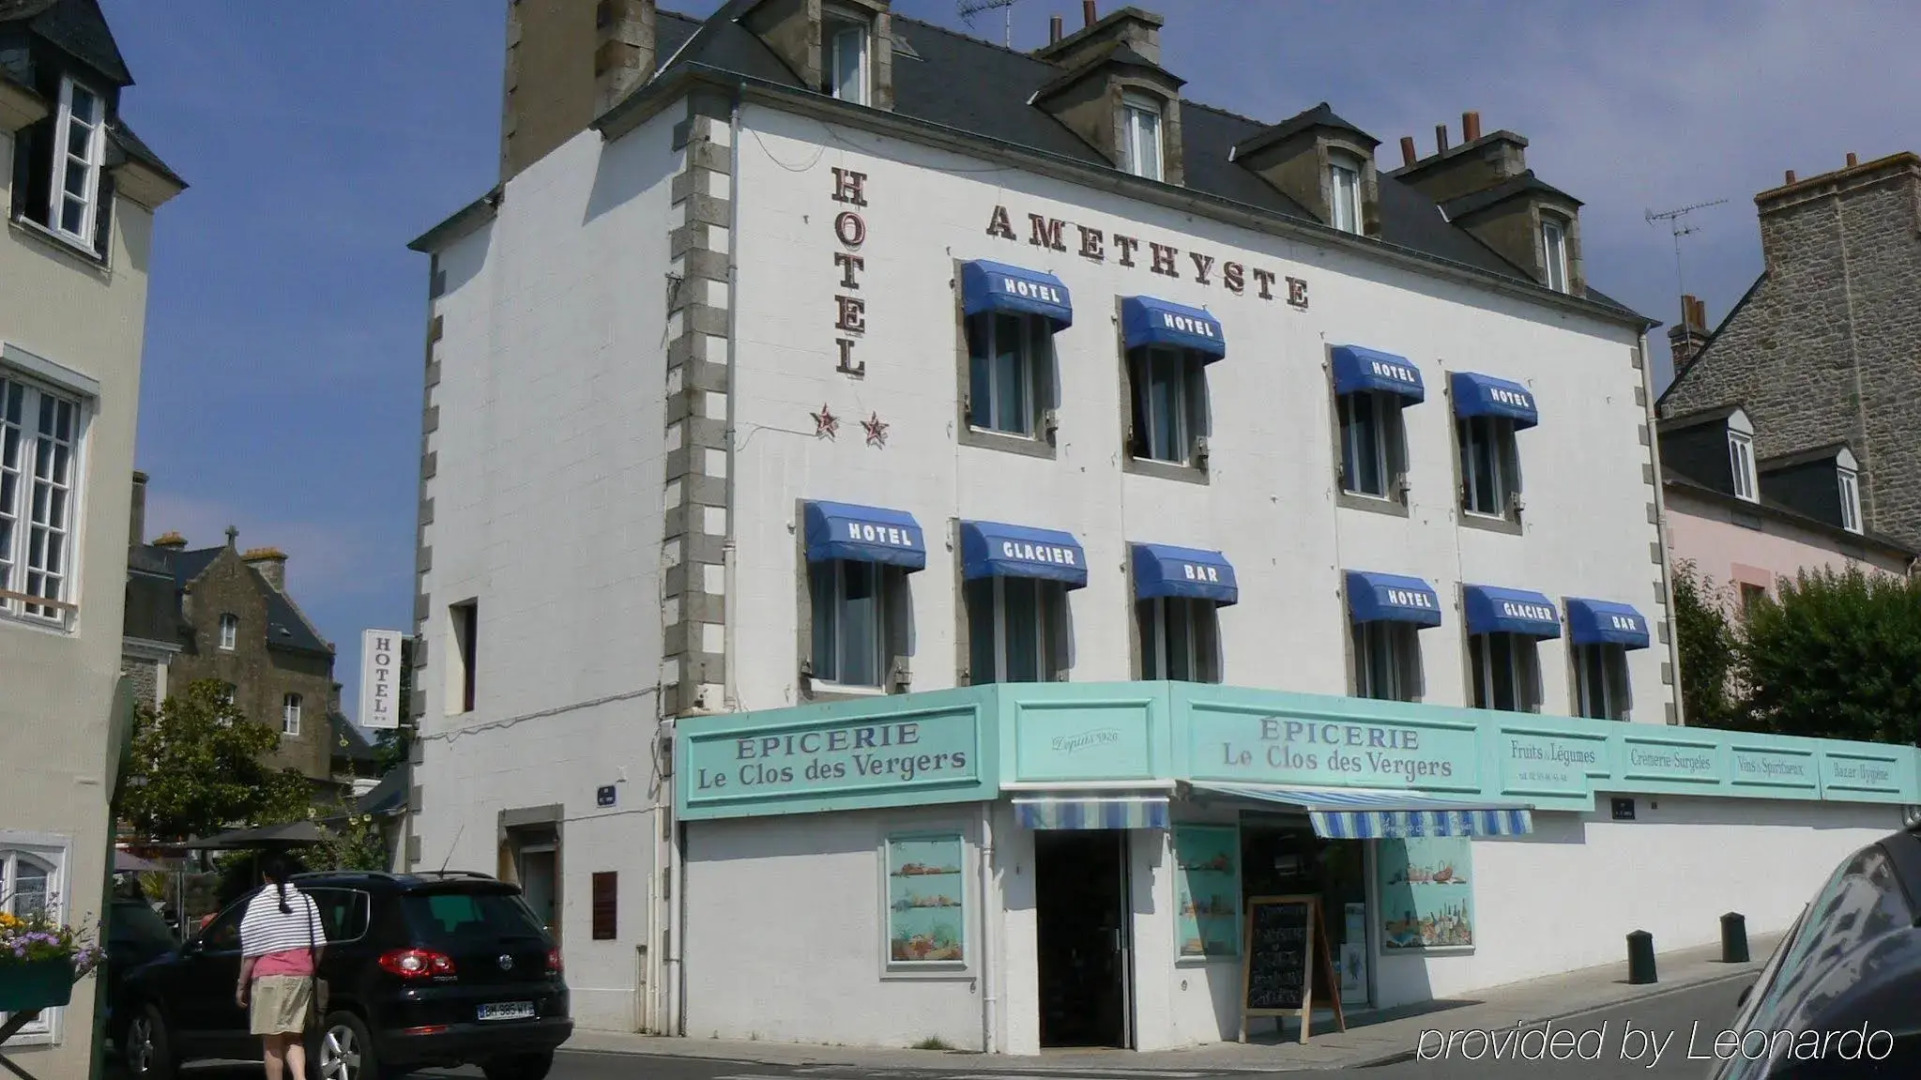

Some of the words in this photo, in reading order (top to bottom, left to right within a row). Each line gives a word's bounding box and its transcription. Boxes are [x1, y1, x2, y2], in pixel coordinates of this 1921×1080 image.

[986, 205, 1309, 309] AMETHYSTE
[831, 167, 867, 377] HOTEL
[1004, 278, 1060, 303] HOTEL
[1163, 313, 1214, 338] HOTEL
[1371, 361, 1415, 382] HOTEL
[1491, 388, 1529, 407] HOTEL
[848, 523, 912, 546] HOTEL
[1003, 541, 1075, 565] GLACIER
[1184, 564, 1218, 582] BAR
[1388, 589, 1432, 608] HOTEL
[1503, 602, 1553, 620] GLACIER
[1612, 615, 1636, 631] BAR
[374, 638, 391, 713] HOTEL
[1223, 743, 1252, 766] Le
[1267, 745, 1318, 770] Clos
[1328, 750, 1362, 772] des
[1366, 751, 1452, 782] Vergers
[1511, 740, 1543, 760] Fruits
[1550, 743, 1596, 767] Légumes
[698, 769, 727, 790] Le
[739, 762, 794, 785] Clos
[805, 758, 846, 780] des
[852, 750, 967, 782] Vergers
